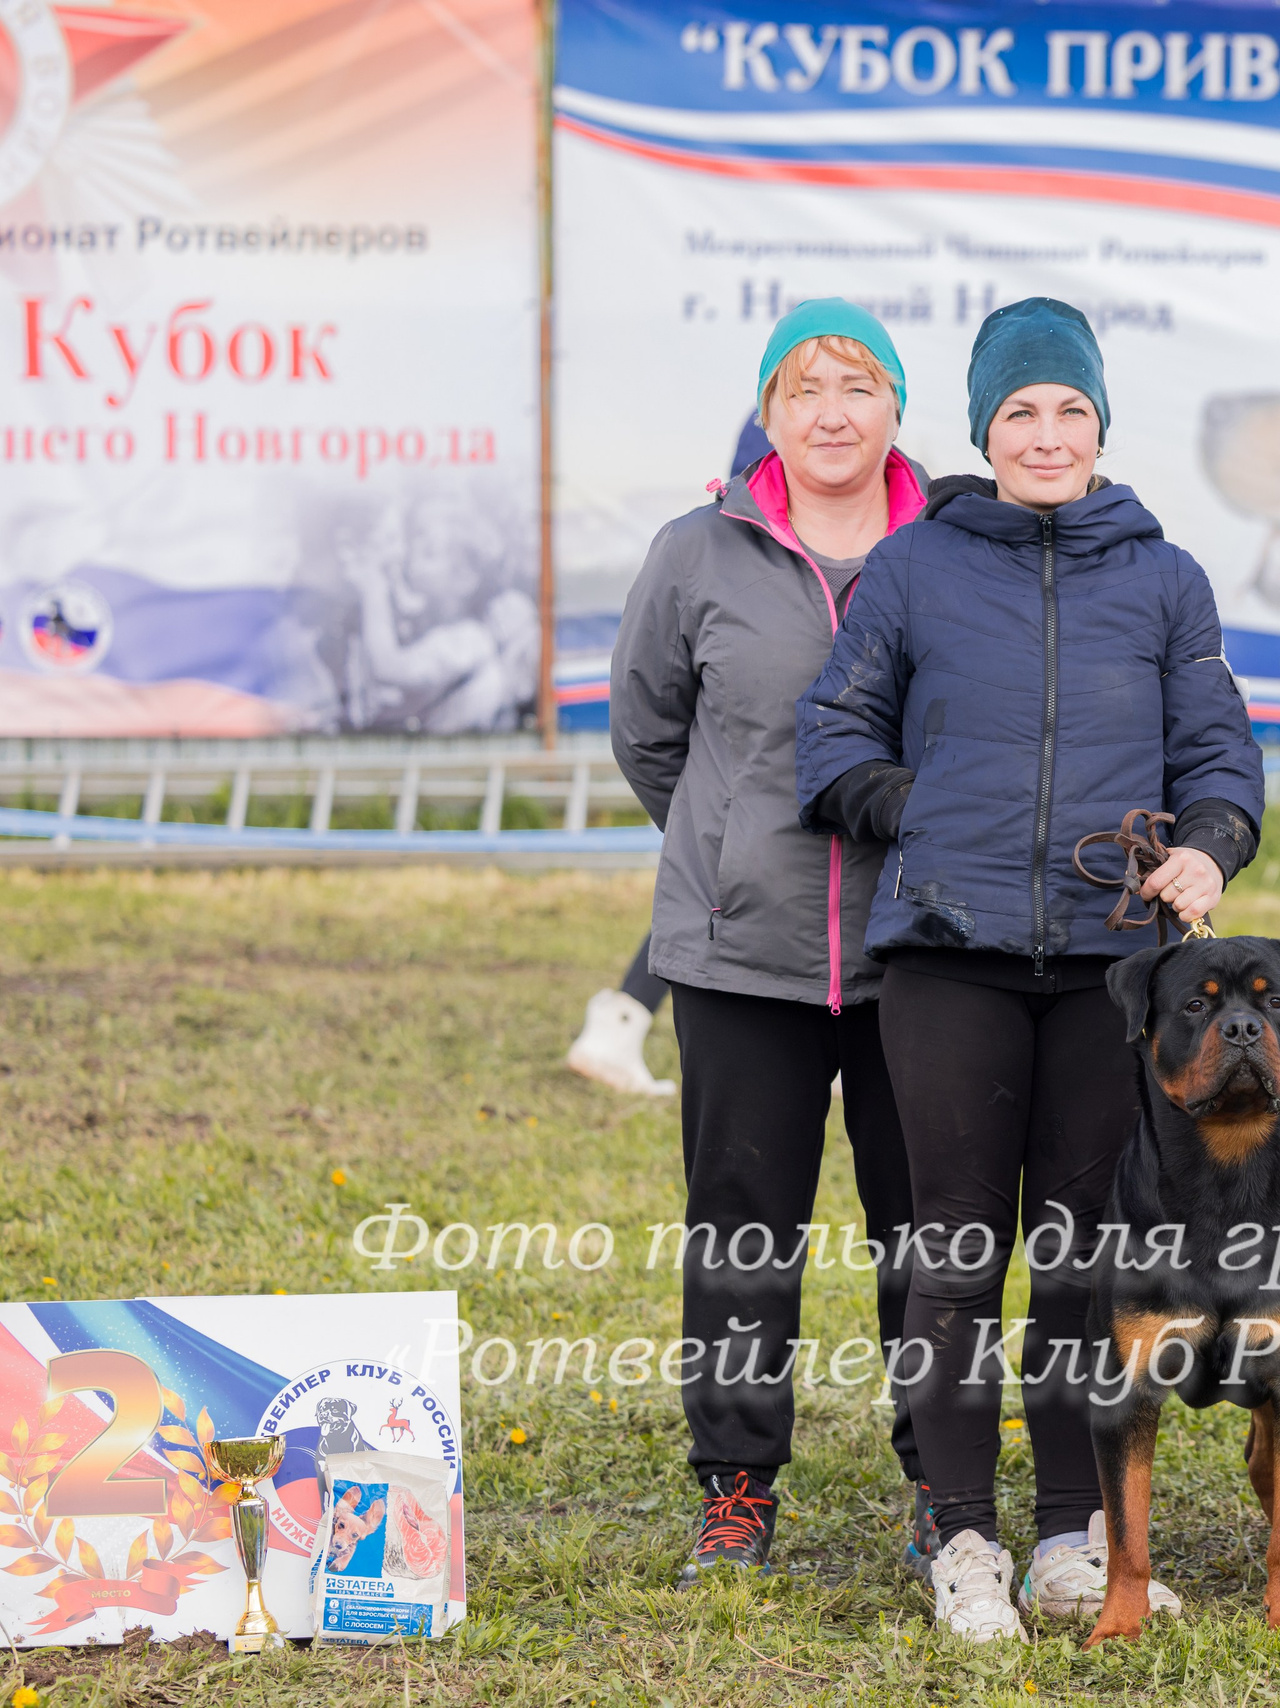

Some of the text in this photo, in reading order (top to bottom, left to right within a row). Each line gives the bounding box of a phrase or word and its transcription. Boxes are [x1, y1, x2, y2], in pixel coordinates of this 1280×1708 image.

[136, 217, 430, 261] Ротвейлеров
[21, 294, 338, 409] Кубок
[164, 410, 497, 481] Новгорода
[46, 1349, 168, 1518] 2
[260, 1369, 332, 1437] ВЕЙЛЕР
[346, 1364, 403, 1386] КЛУБ
[337, 1579, 395, 1592] STATERA
[351, 1622, 384, 1630] ЛОСОСЕМ
